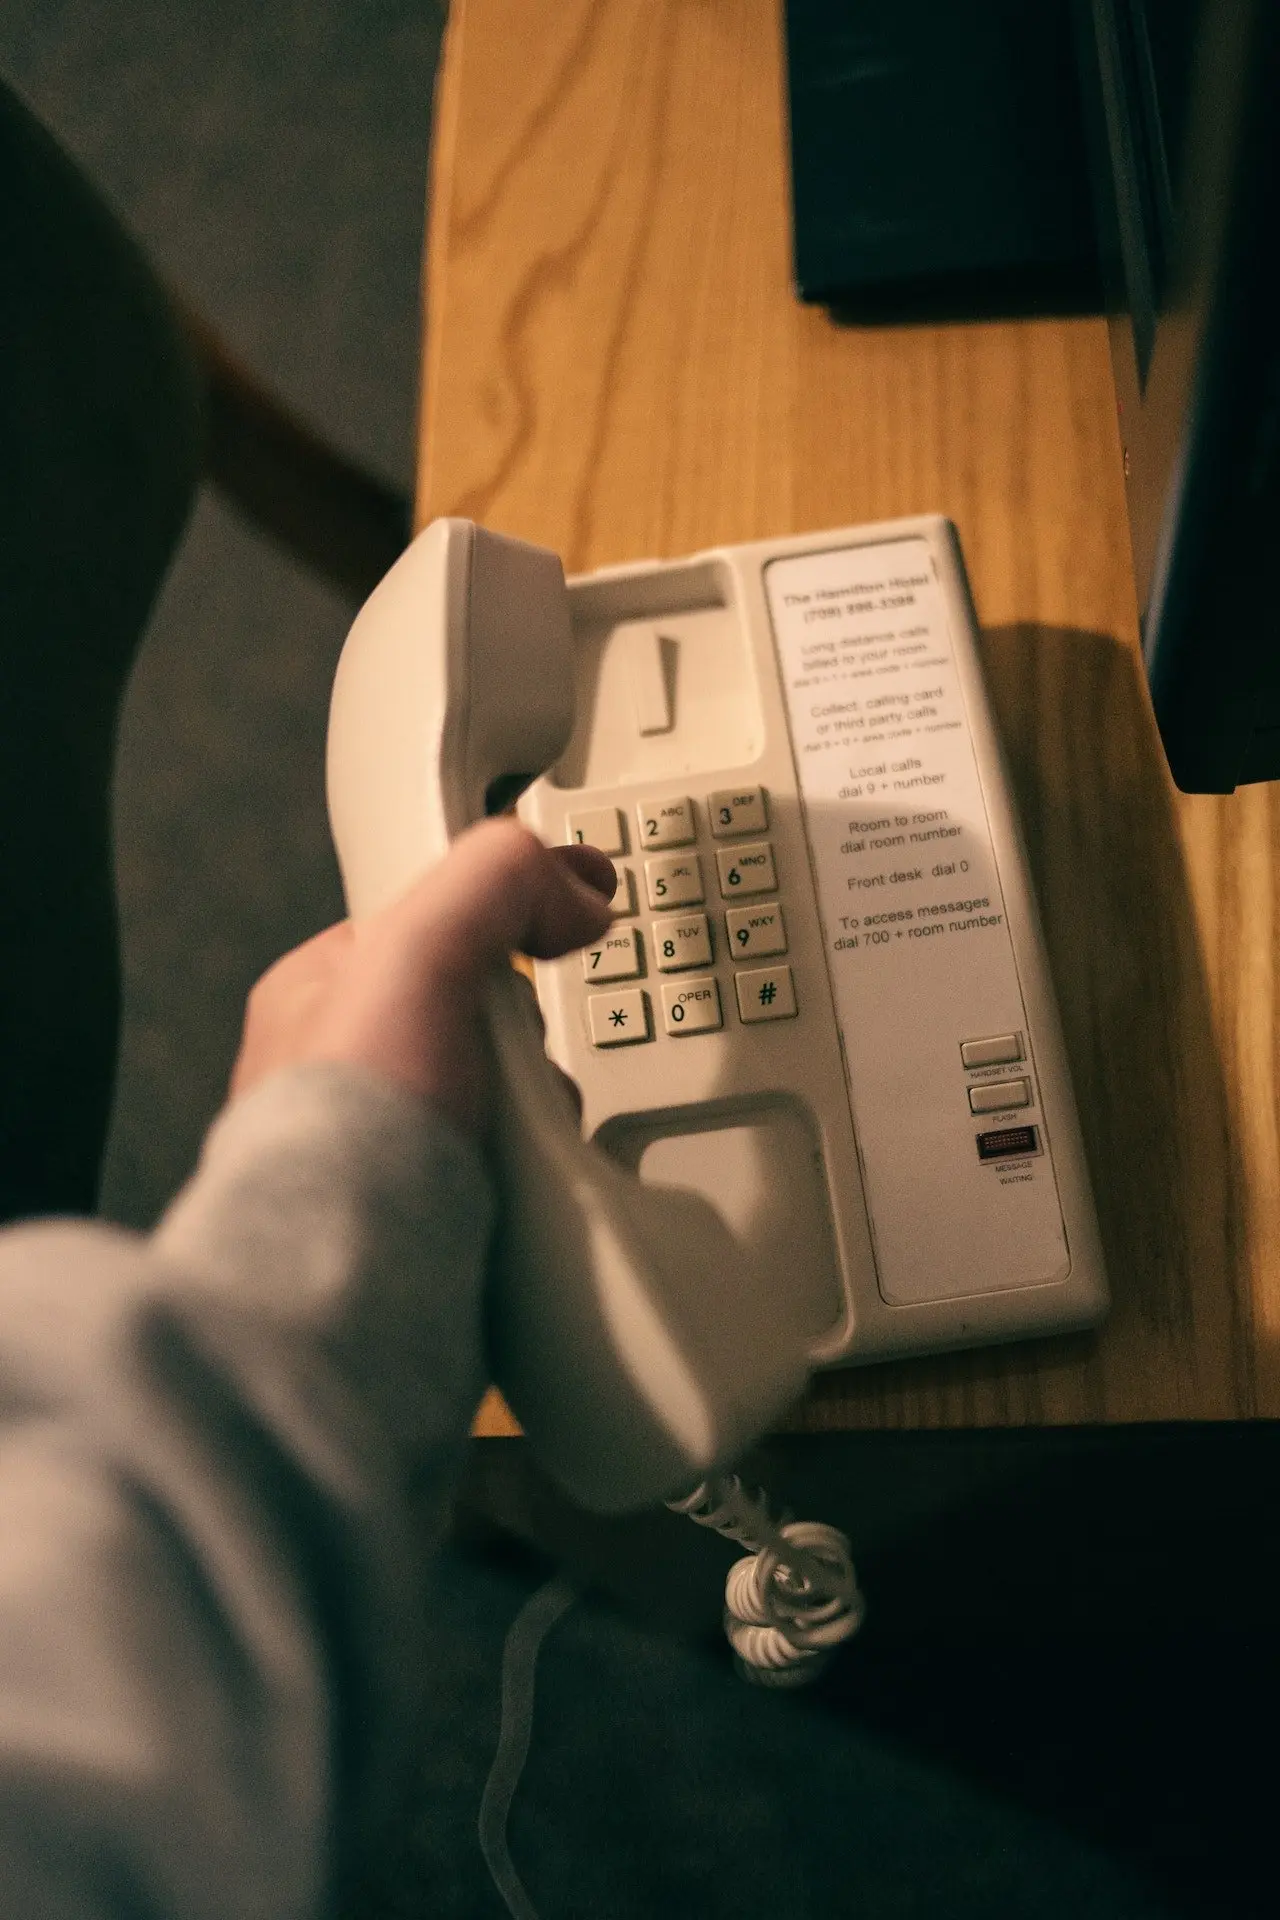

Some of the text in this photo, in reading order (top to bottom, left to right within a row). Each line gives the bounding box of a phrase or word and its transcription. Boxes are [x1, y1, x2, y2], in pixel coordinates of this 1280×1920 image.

[783, 573, 929, 608] The Hamilton Hotel
[801, 626, 929, 655] Long distance calls
[803, 644, 927, 671] billed to your room
[866, 694, 910, 709] calling
[914, 688, 944, 701] card
[817, 706, 937, 735] or third party calls
[862, 733, 885, 744] area
[888, 728, 912, 740] code
[925, 721, 962, 734] number
[850, 758, 922, 779] Local calls
[839, 773, 945, 800] dial 9 + number
[647, 806, 684, 837] 2 ABC
[720, 795, 754, 825] 3 DEF
[849, 810, 949, 834] Room to room
[840, 826, 963, 855] dial room number
[656, 868, 691, 896] 5 JKL
[728, 855, 766, 886] 6 MNO
[848, 860, 969, 890] Front desk dial 0
[839, 897, 990, 930] To access messages
[664, 927, 701, 957] 8 TUV
[737, 916, 775, 948] 9 WXY
[834, 914, 1003, 951] dial 700 + room number
[590, 938, 630, 969] 7 PRS
[672, 989, 711, 1022] 0 OPER
[759, 982, 777, 1005] #
[971, 1067, 1005, 1079] HANDSET
[992, 1114, 1016, 1123] FLASH
[996, 1161, 1033, 1173] MESSAGE
[1000, 1175, 1033, 1186] WAITING
